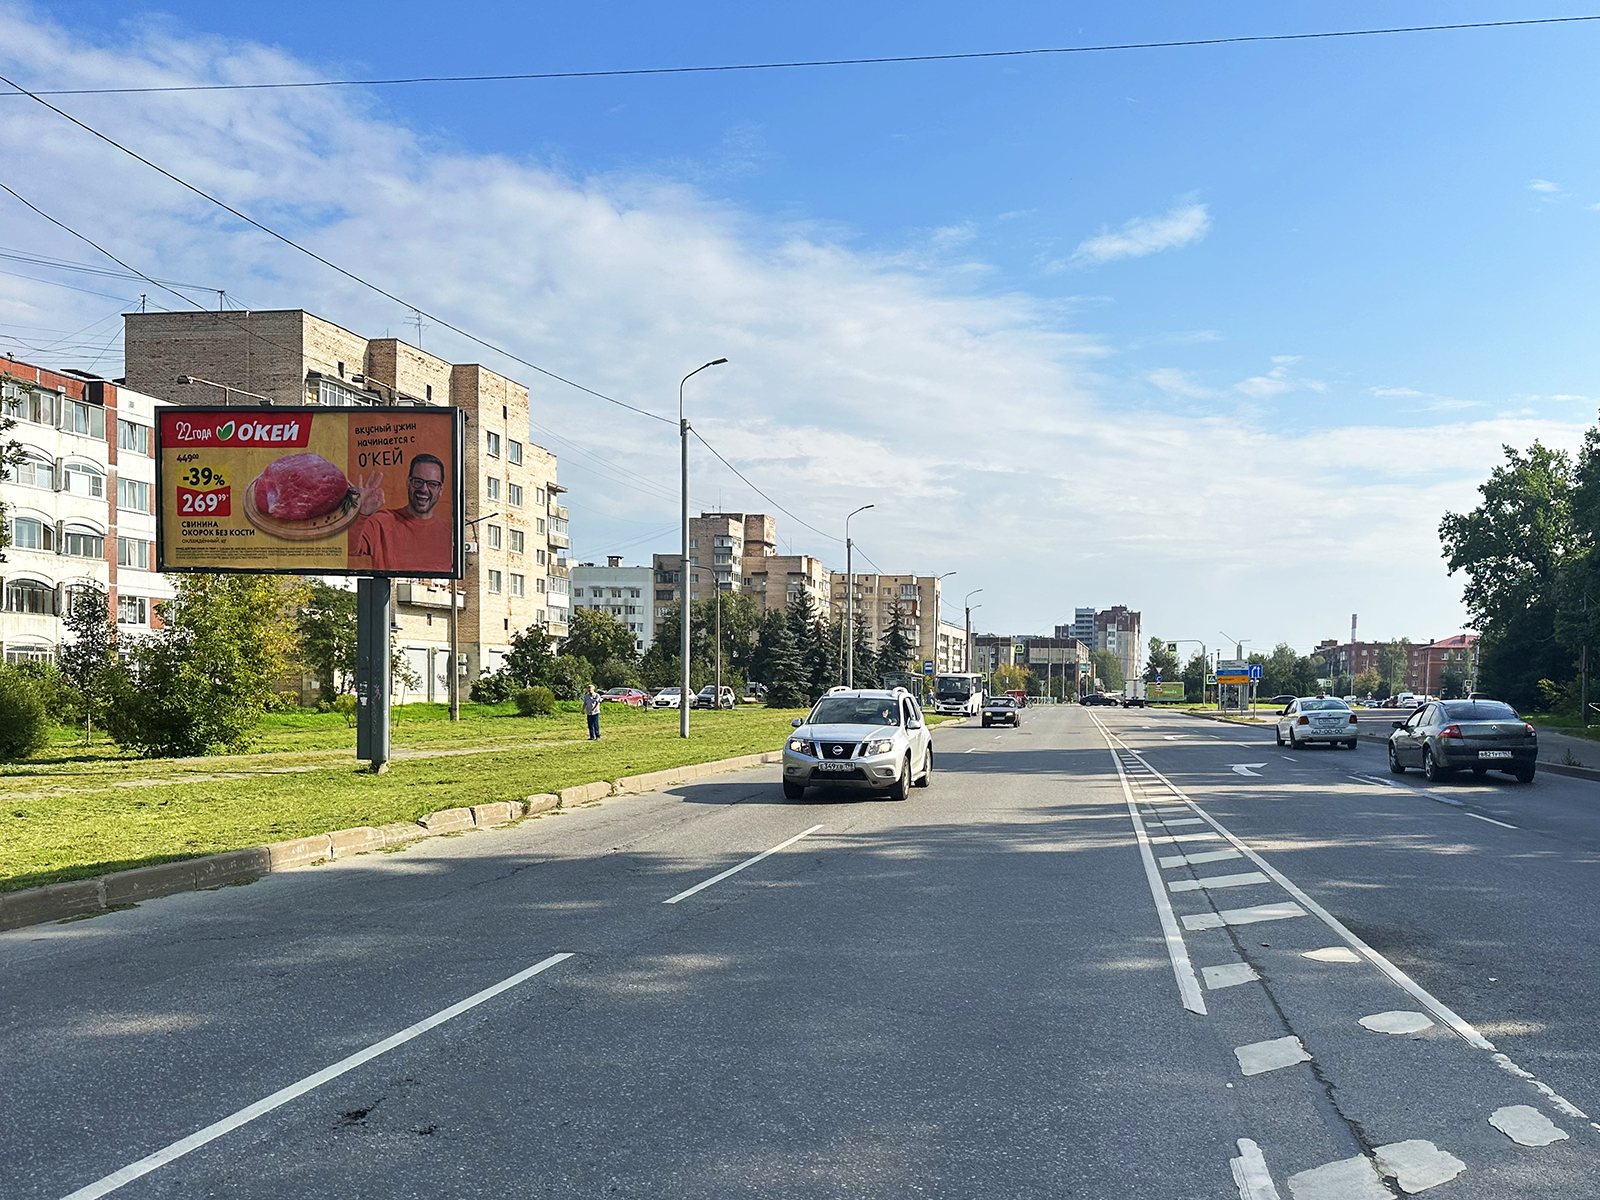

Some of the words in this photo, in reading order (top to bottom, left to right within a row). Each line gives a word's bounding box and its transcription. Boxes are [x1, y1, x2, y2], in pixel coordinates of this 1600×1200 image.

[355, 423, 391, 436] вкусный
[393, 423, 417, 433] ужин
[357, 436, 408, 447] начинается
[181, 529, 214, 537] ОКОРОК
[215, 529, 229, 537] БЕЗ
[229, 528, 255, 537] КОСТИ
